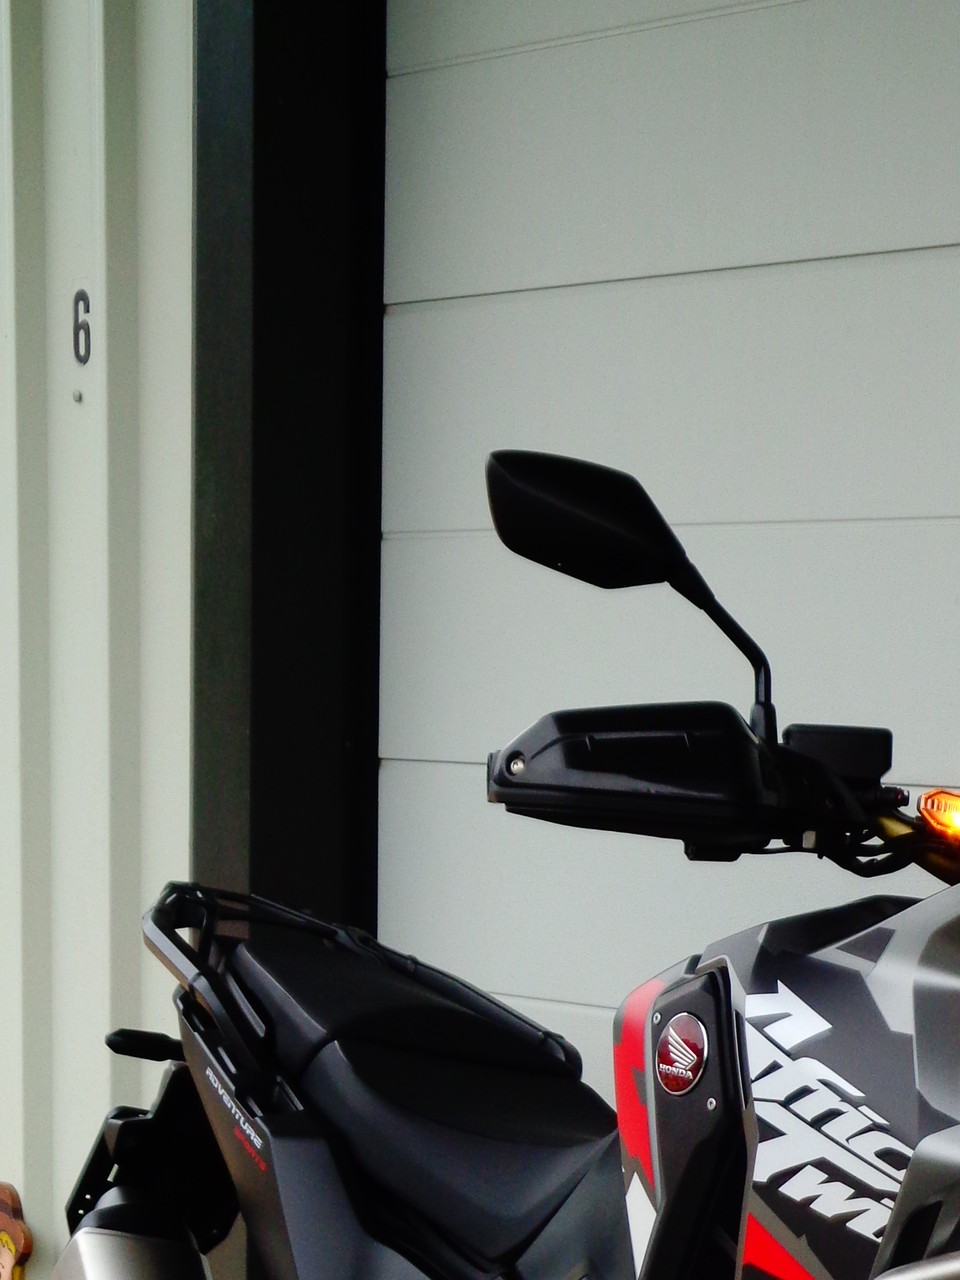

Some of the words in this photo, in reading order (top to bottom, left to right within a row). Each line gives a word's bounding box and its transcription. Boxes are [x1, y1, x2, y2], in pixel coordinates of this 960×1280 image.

[73, 288, 91, 365] 6
[205, 1066, 263, 1149] ADVENTURE
[658, 1063, 694, 1080] HONDA
[745, 979, 915, 1184] Afric
[752, 1100, 901, 1243] Twi
